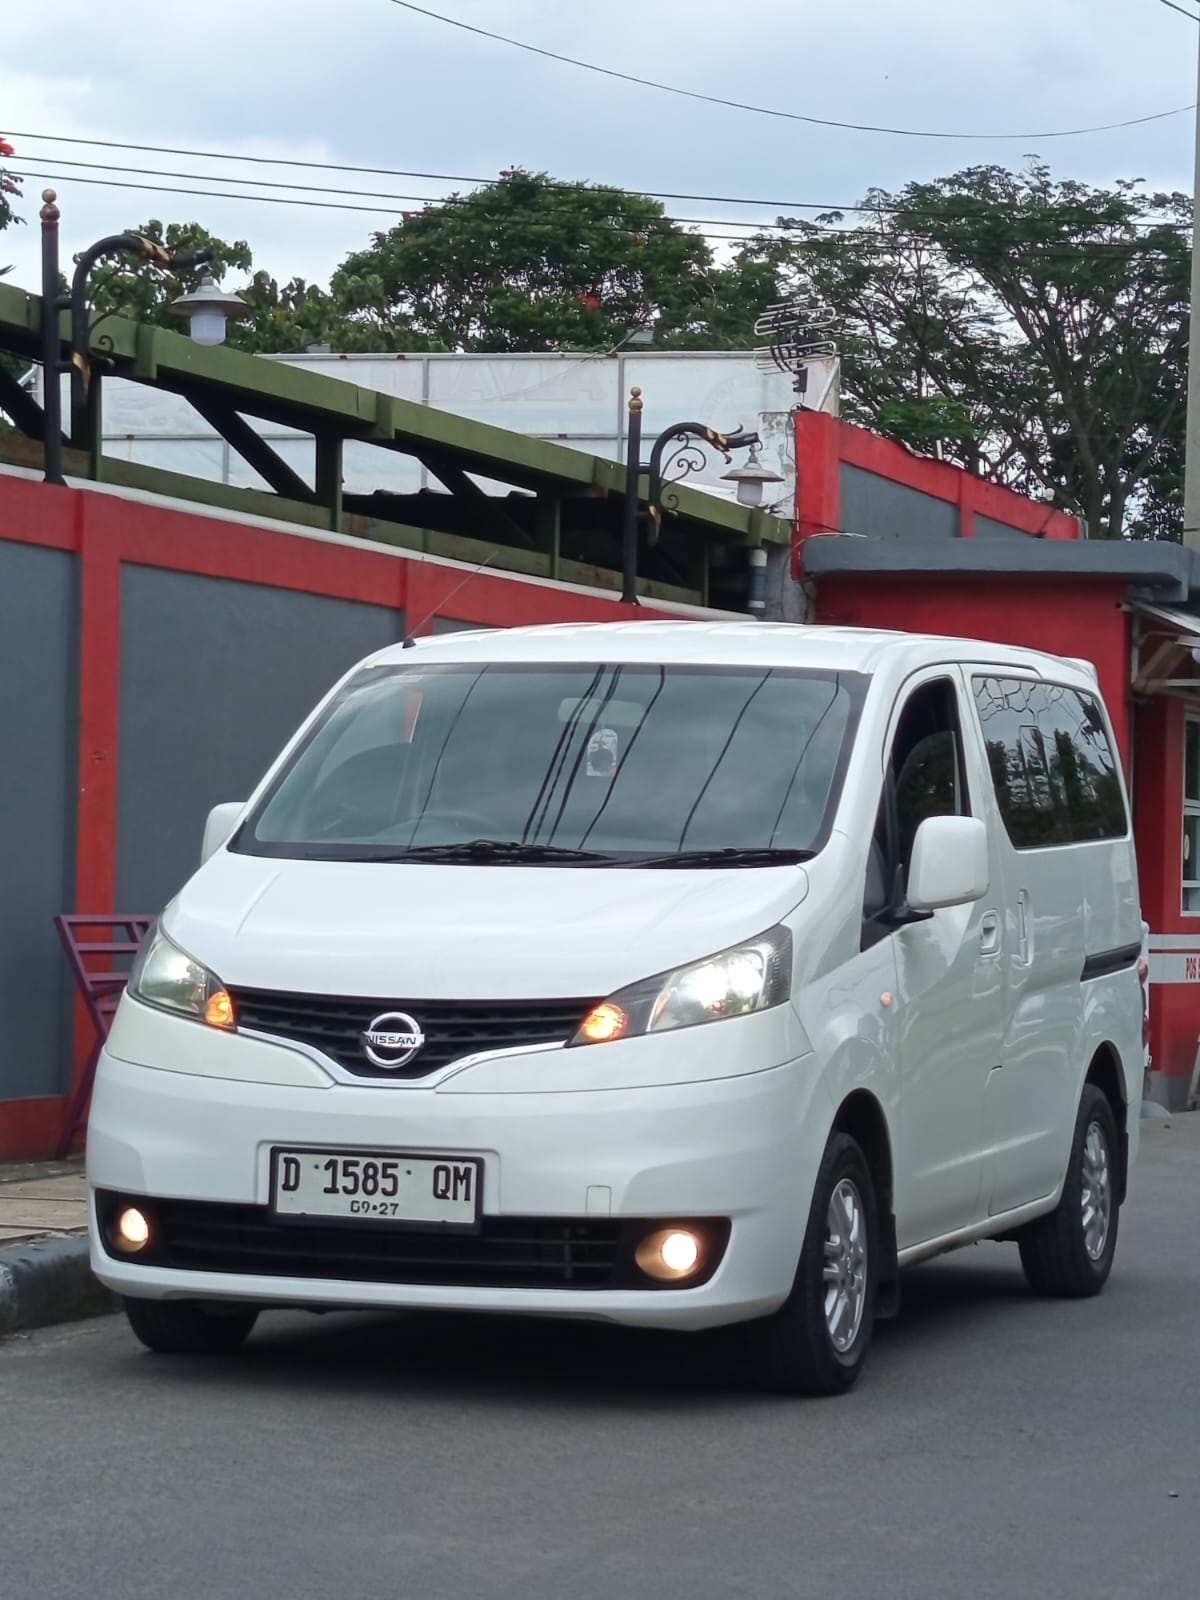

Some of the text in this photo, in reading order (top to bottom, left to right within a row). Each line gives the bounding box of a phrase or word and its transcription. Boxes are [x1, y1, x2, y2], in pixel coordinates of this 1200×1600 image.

[366, 1035, 417, 1045] NISSAN
[282, 1156, 472, 1202] D 1585 QM
